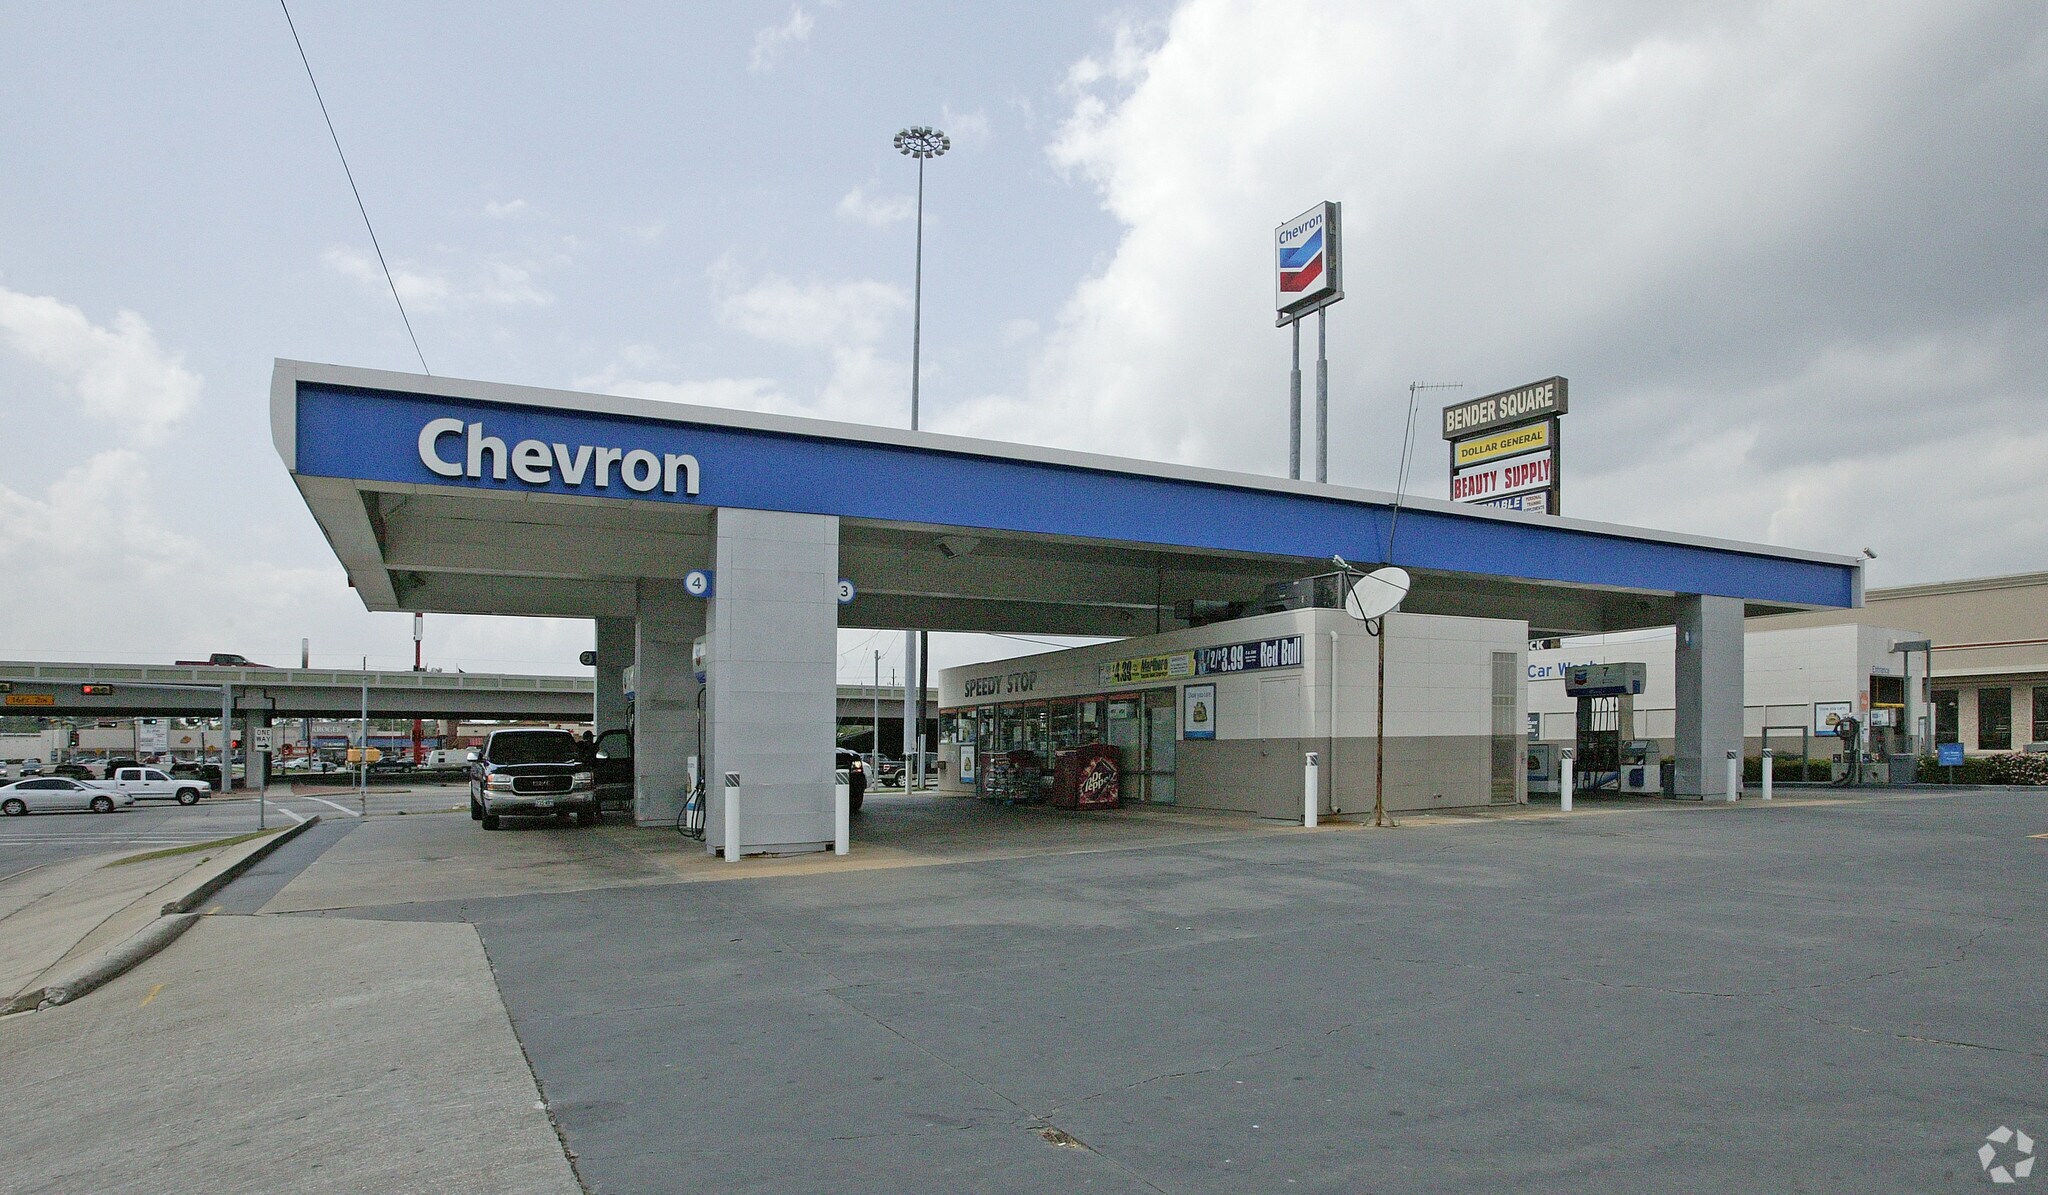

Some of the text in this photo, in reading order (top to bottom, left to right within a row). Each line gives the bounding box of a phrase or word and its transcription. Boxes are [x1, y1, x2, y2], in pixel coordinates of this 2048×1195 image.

[1279, 214, 1322, 244] Chevron
[1446, 384, 1553, 432] BENDER SQUARE
[418, 418, 699, 495] Chevron
[1461, 431, 1543, 458] DOLLAR GENERAL
[1454, 459, 1550, 499] BEAUTY SUPPLY
[692, 577, 702, 589] 4
[840, 585, 848, 597] 3
[1260, 640, 1279, 667] Red
[1281, 637, 1300, 665] Bull
[964, 671, 1037, 697] SPEEDY STOP
[1528, 664, 1552, 678] Car
[1603, 667, 1610, 677] 7
[311, 725, 342, 733] KROGER
[1092, 771, 1103, 781] Dr
